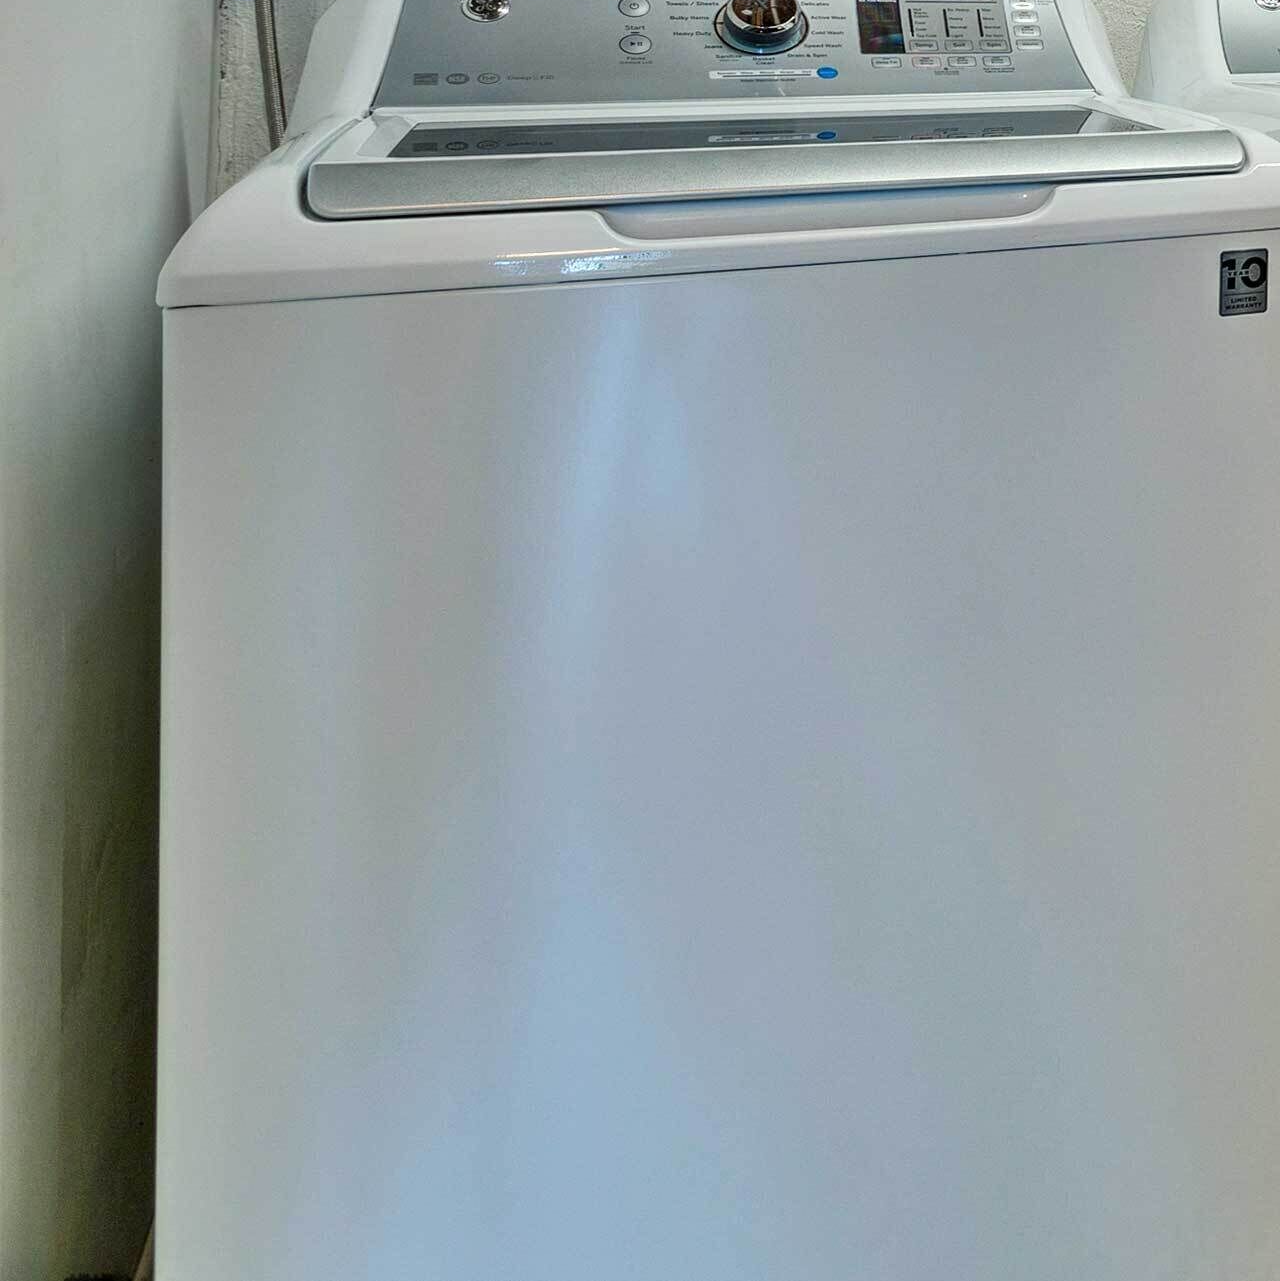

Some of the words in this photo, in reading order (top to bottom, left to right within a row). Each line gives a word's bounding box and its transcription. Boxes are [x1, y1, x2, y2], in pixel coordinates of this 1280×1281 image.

[1221, 256, 1268, 290] 10
[1229, 296, 1257, 304] LIMITED
[1224, 302, 1263, 310] WARRANTY
